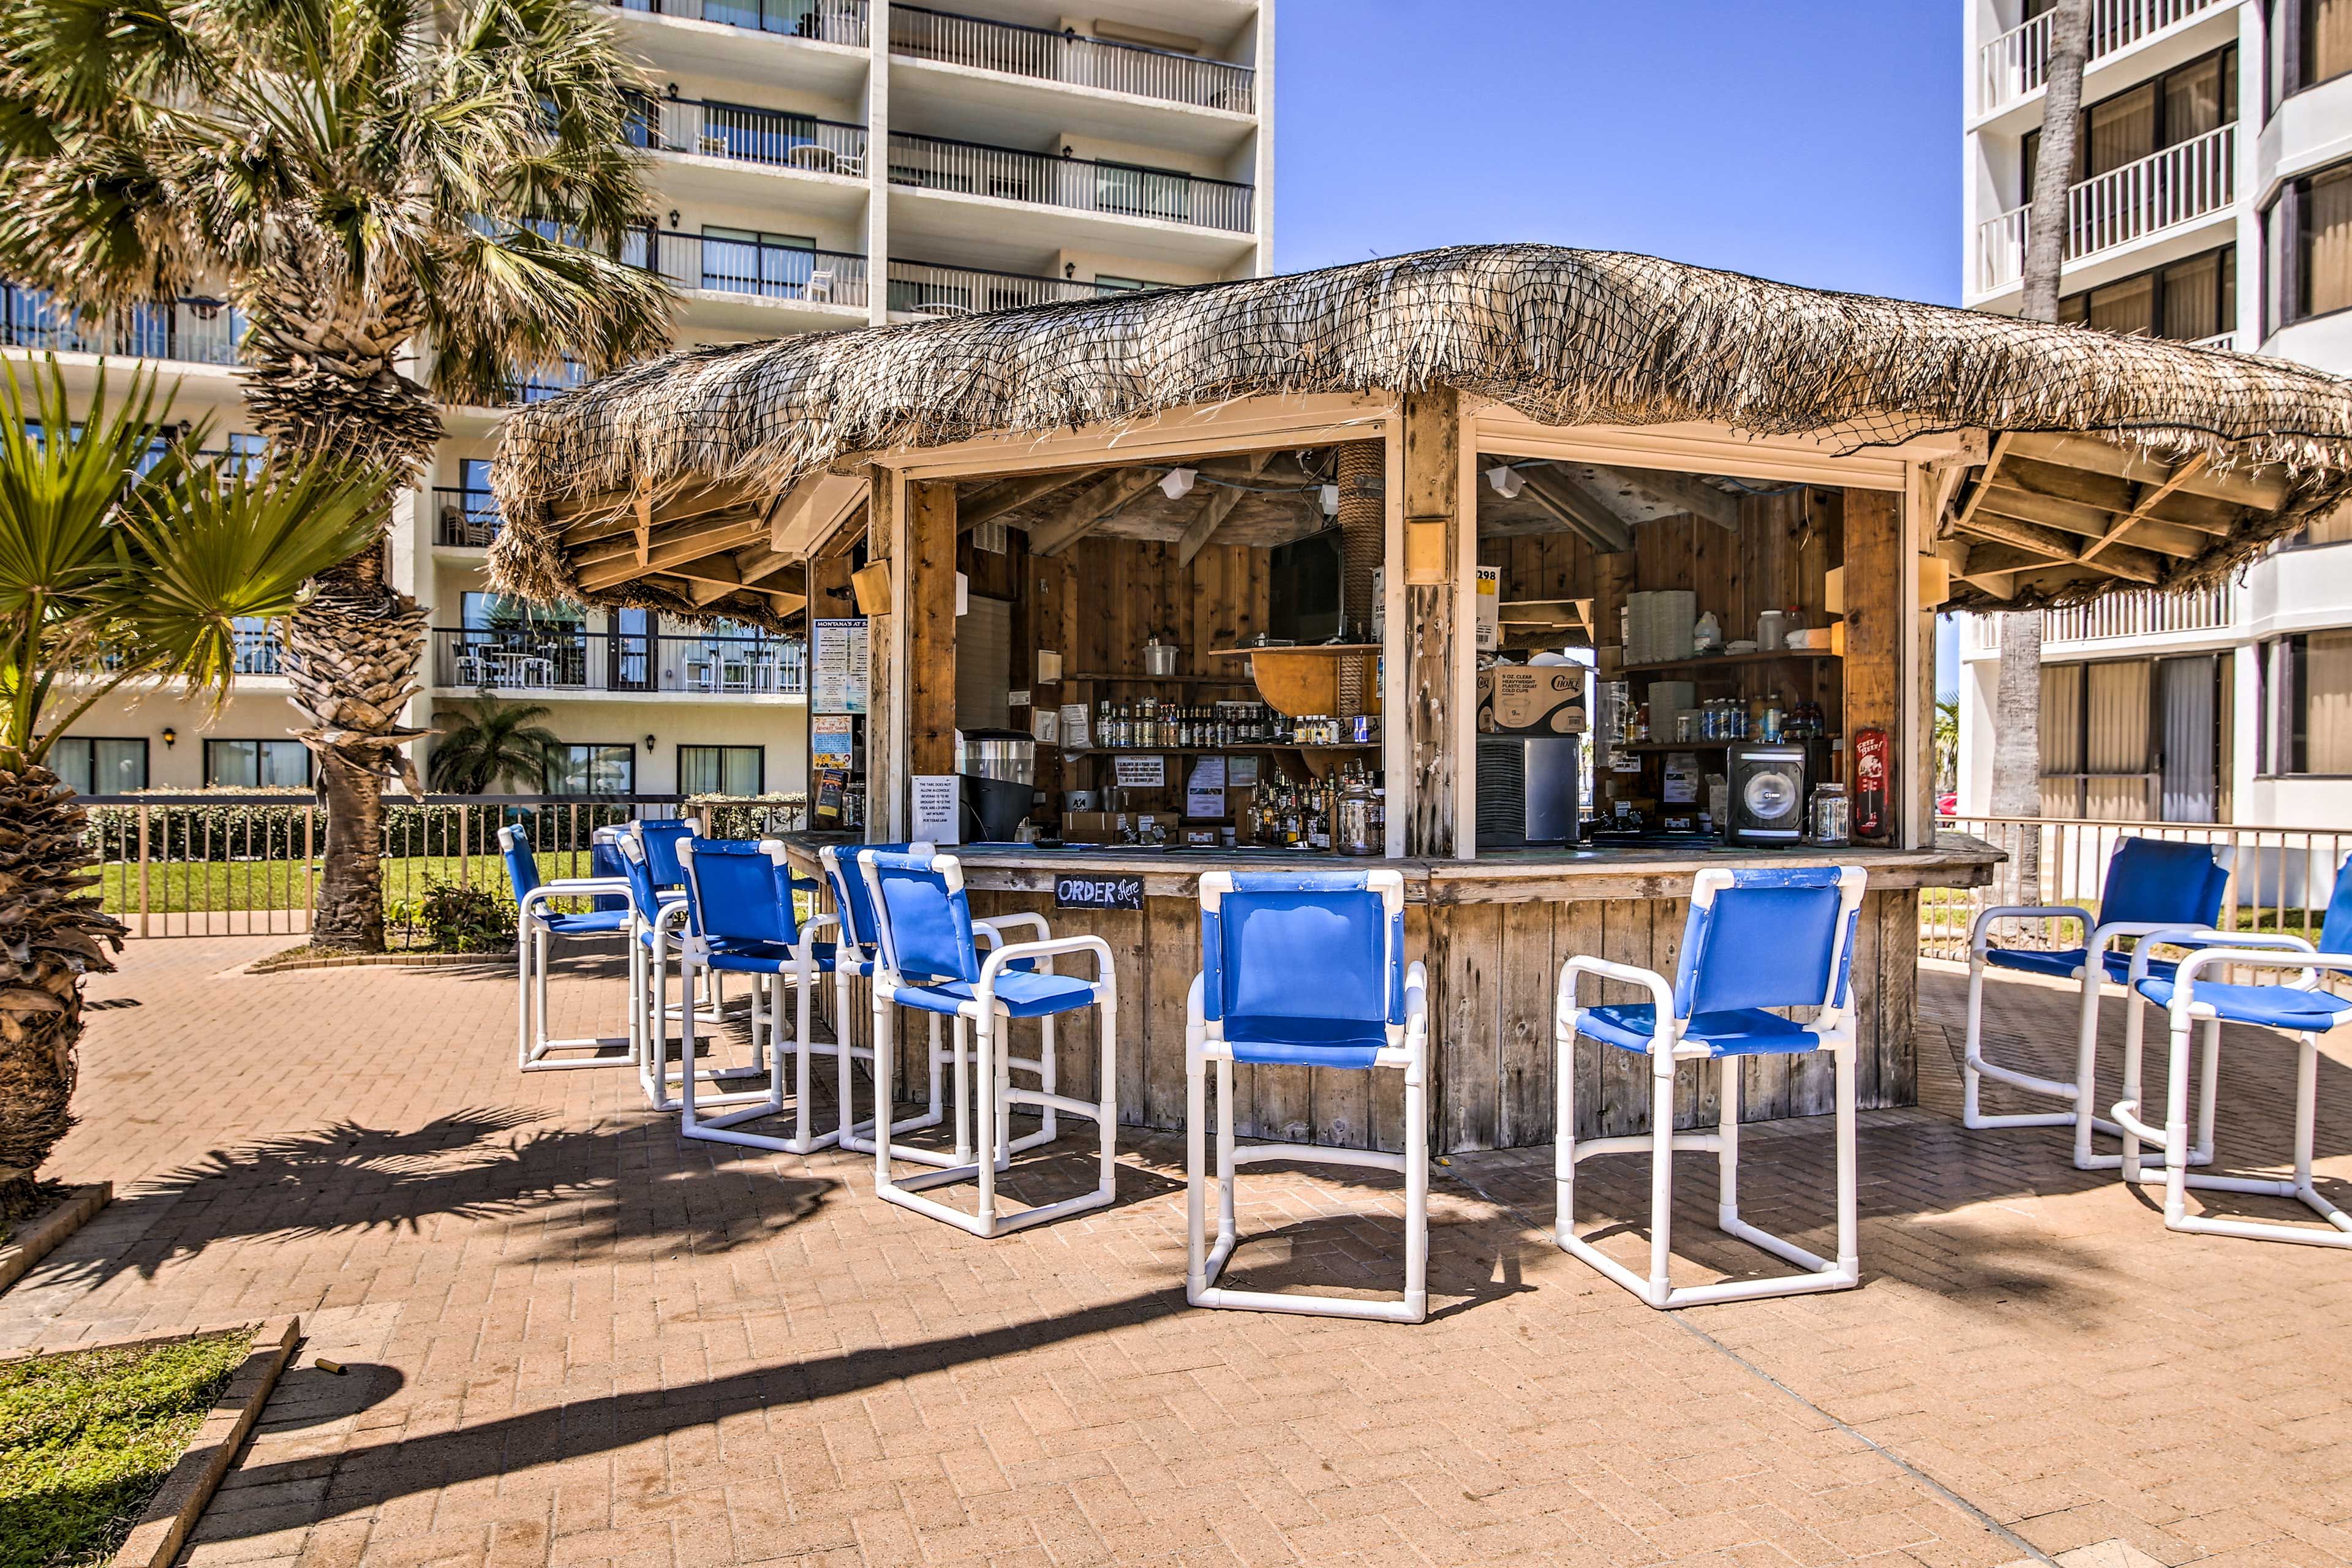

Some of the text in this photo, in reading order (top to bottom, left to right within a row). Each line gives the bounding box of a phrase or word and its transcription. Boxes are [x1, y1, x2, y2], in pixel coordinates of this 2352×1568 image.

[1551, 675, 1580, 692] CHOICE
[1856, 739, 1875, 753] FREE
[1861, 741, 1883, 757] BEER!
[1058, 878, 1140, 903] ORDER Here
